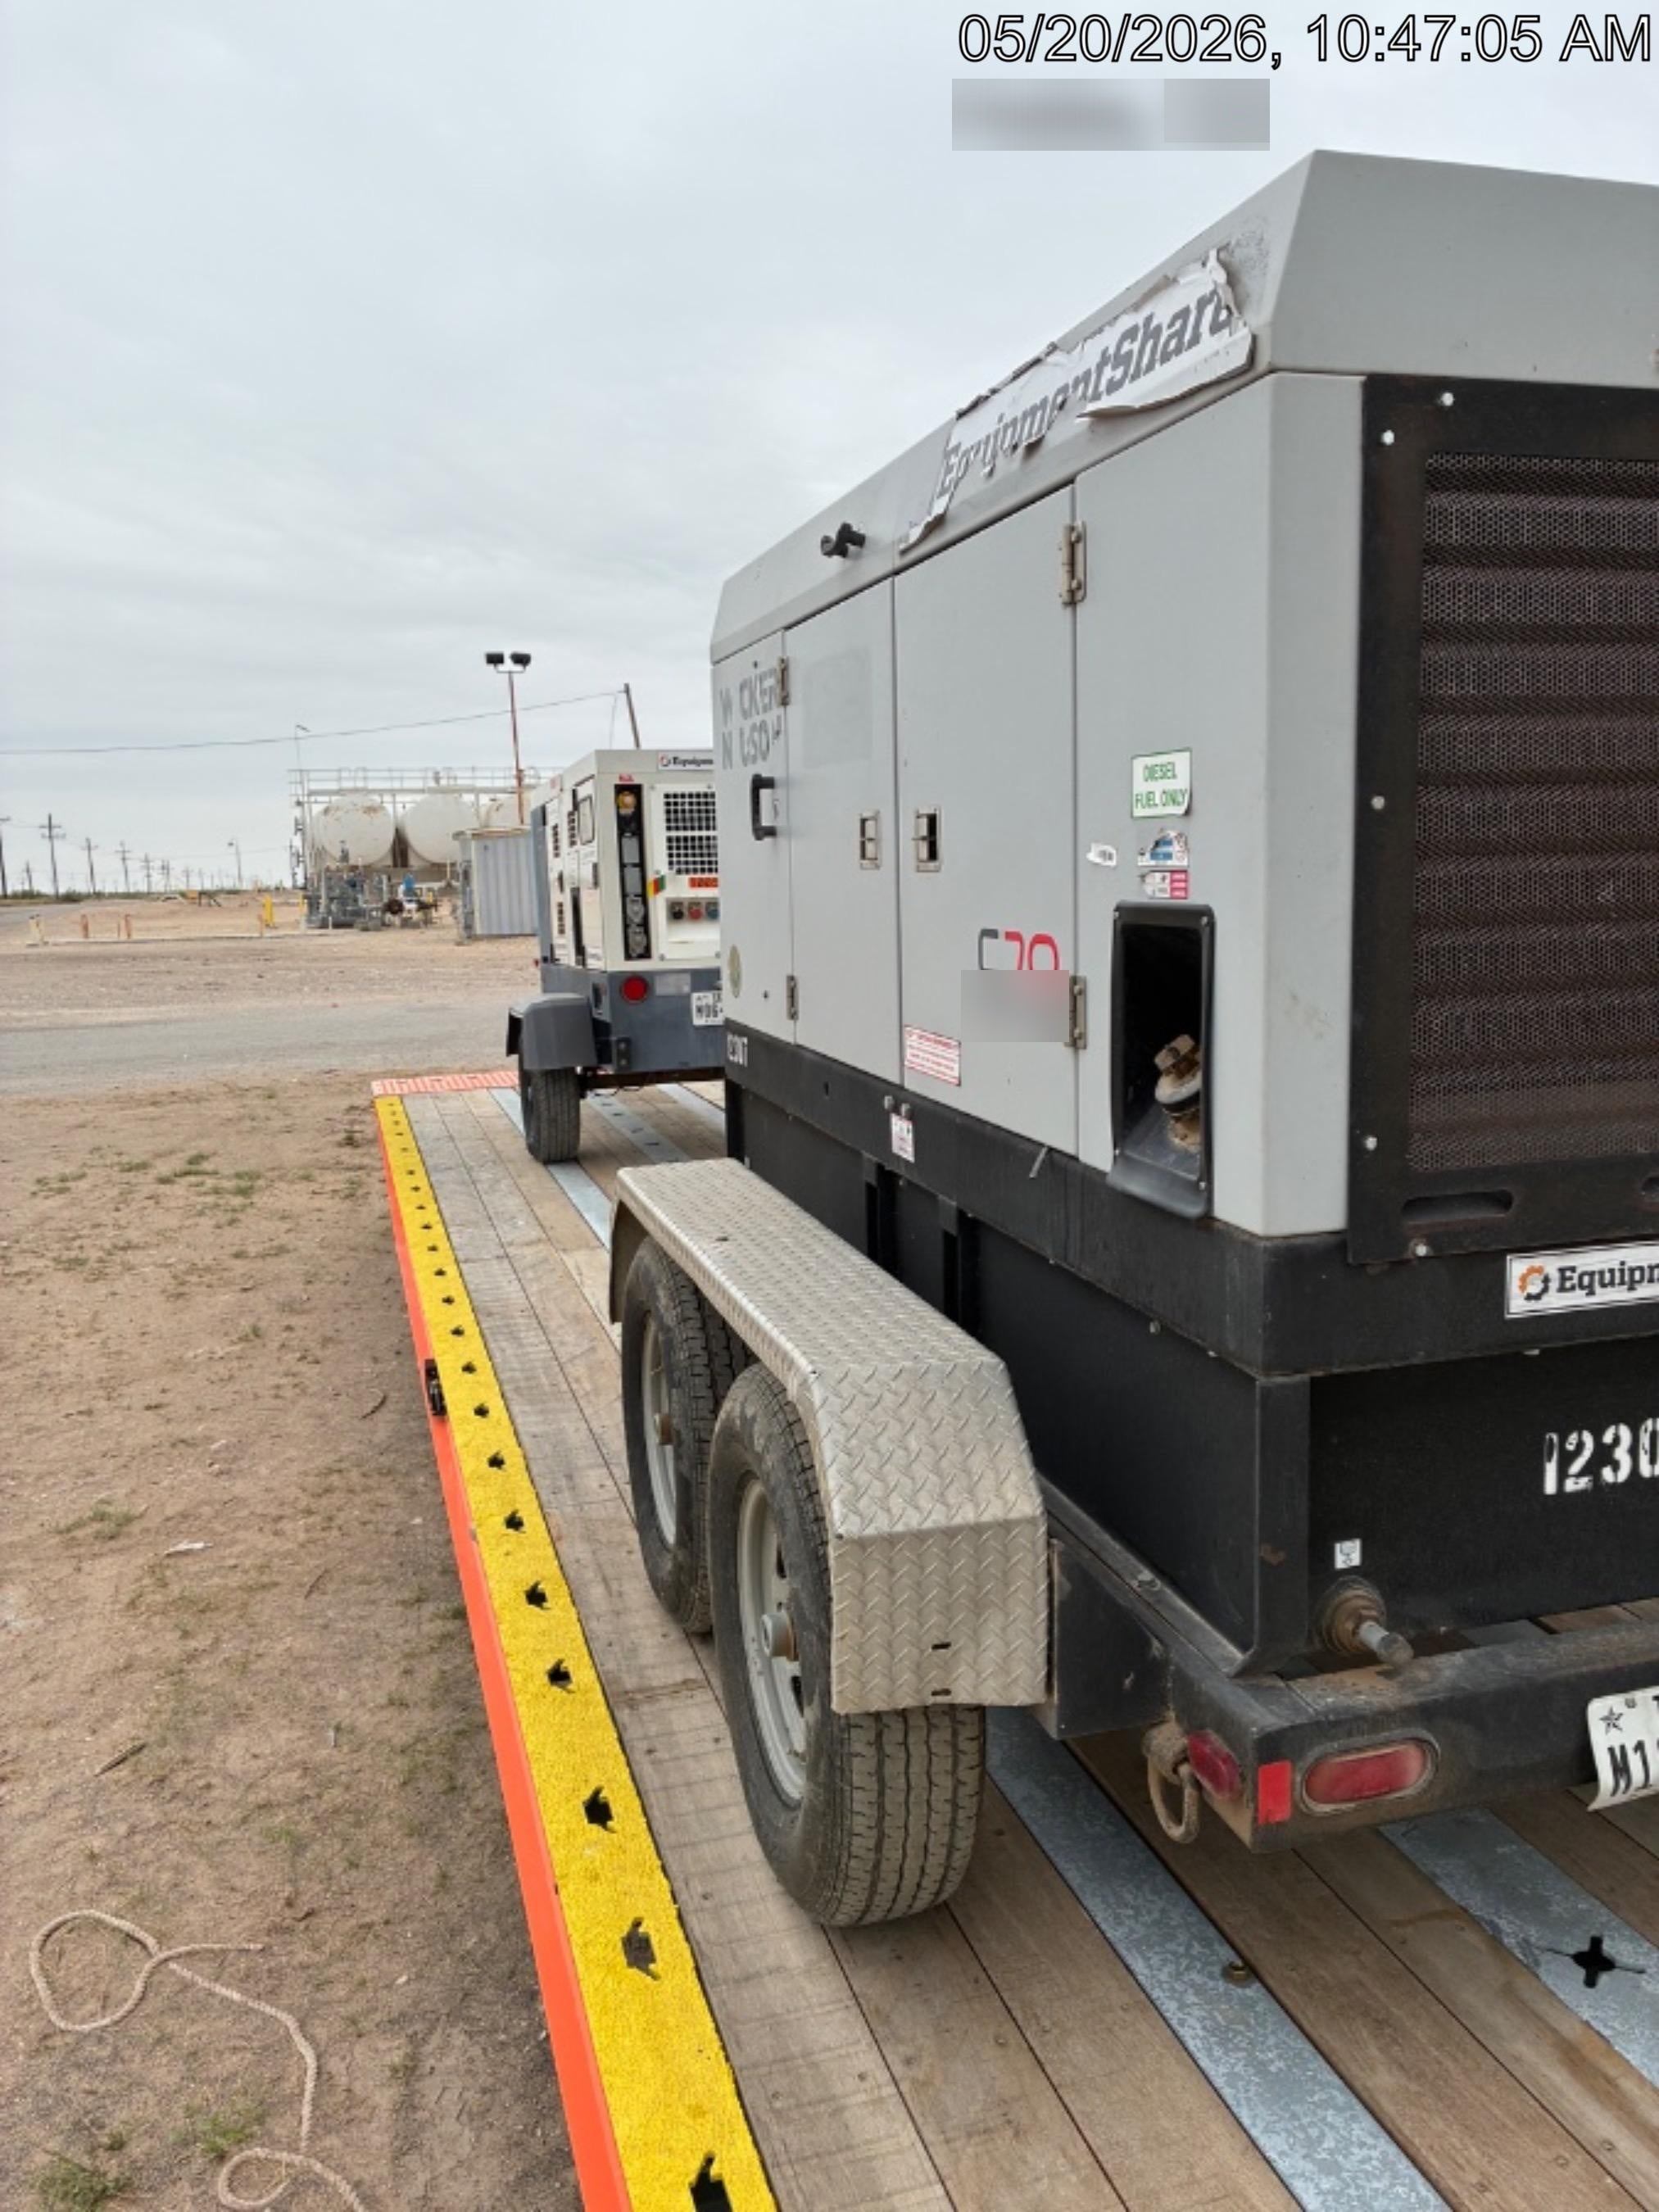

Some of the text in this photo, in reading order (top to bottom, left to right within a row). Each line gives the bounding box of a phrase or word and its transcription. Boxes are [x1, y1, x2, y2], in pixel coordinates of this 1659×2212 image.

[1143, 762, 1176, 782] DIESEL
[1135, 787, 1187, 809] FUEL ONLY
